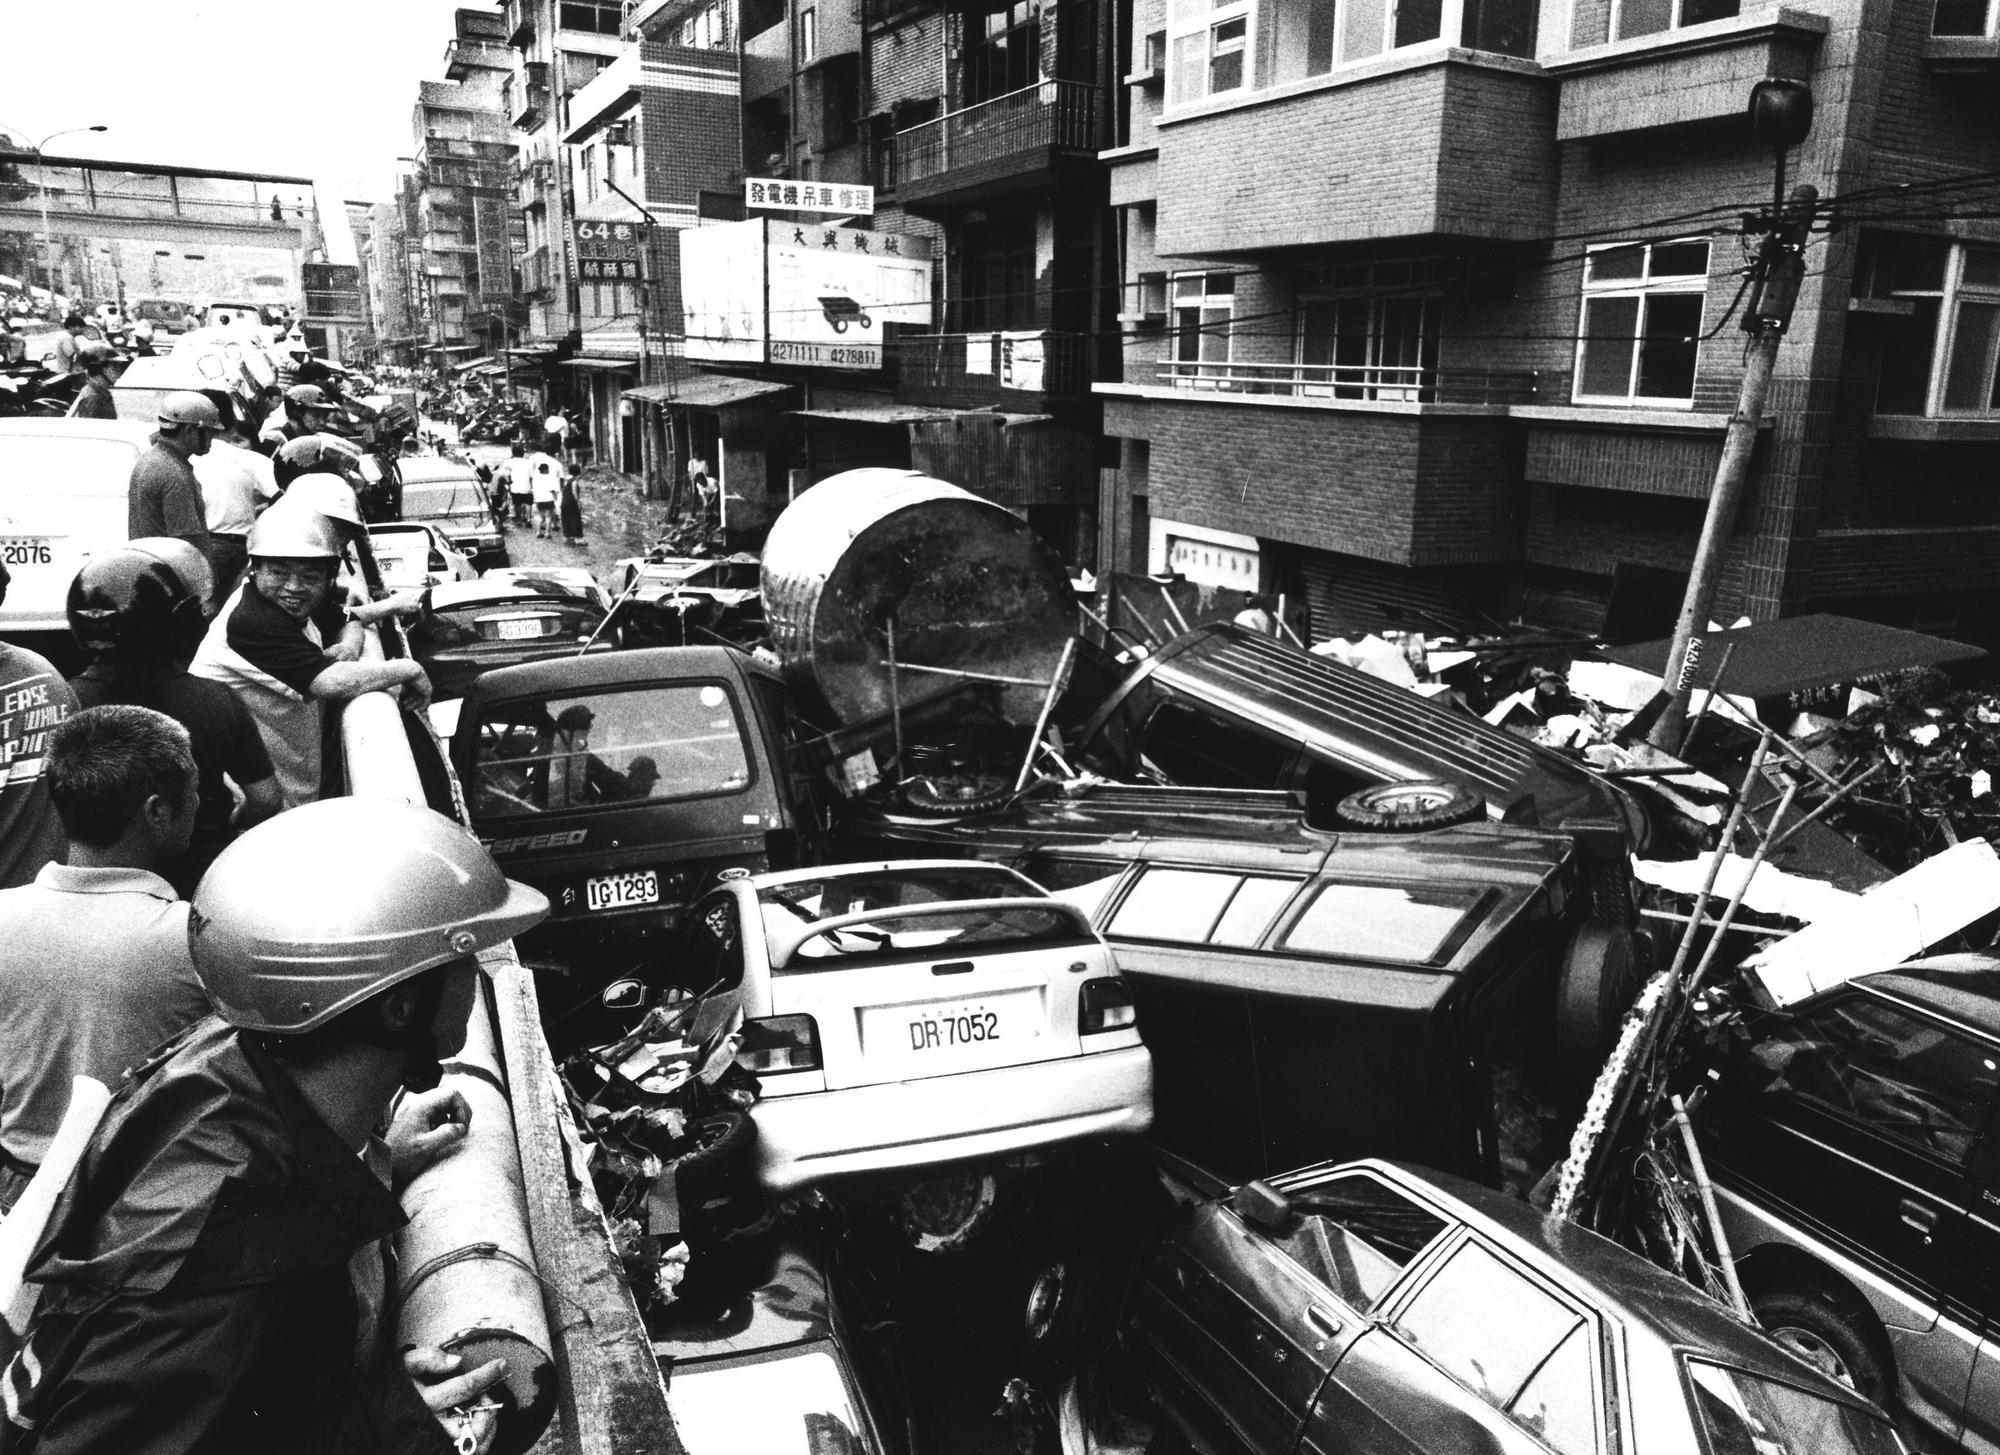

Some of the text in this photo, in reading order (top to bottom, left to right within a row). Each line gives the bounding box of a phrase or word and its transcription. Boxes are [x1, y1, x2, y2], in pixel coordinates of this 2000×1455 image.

[751, 182, 870, 211] 發電機吊車修理
[772, 343, 876, 365] 4271111 4278811
